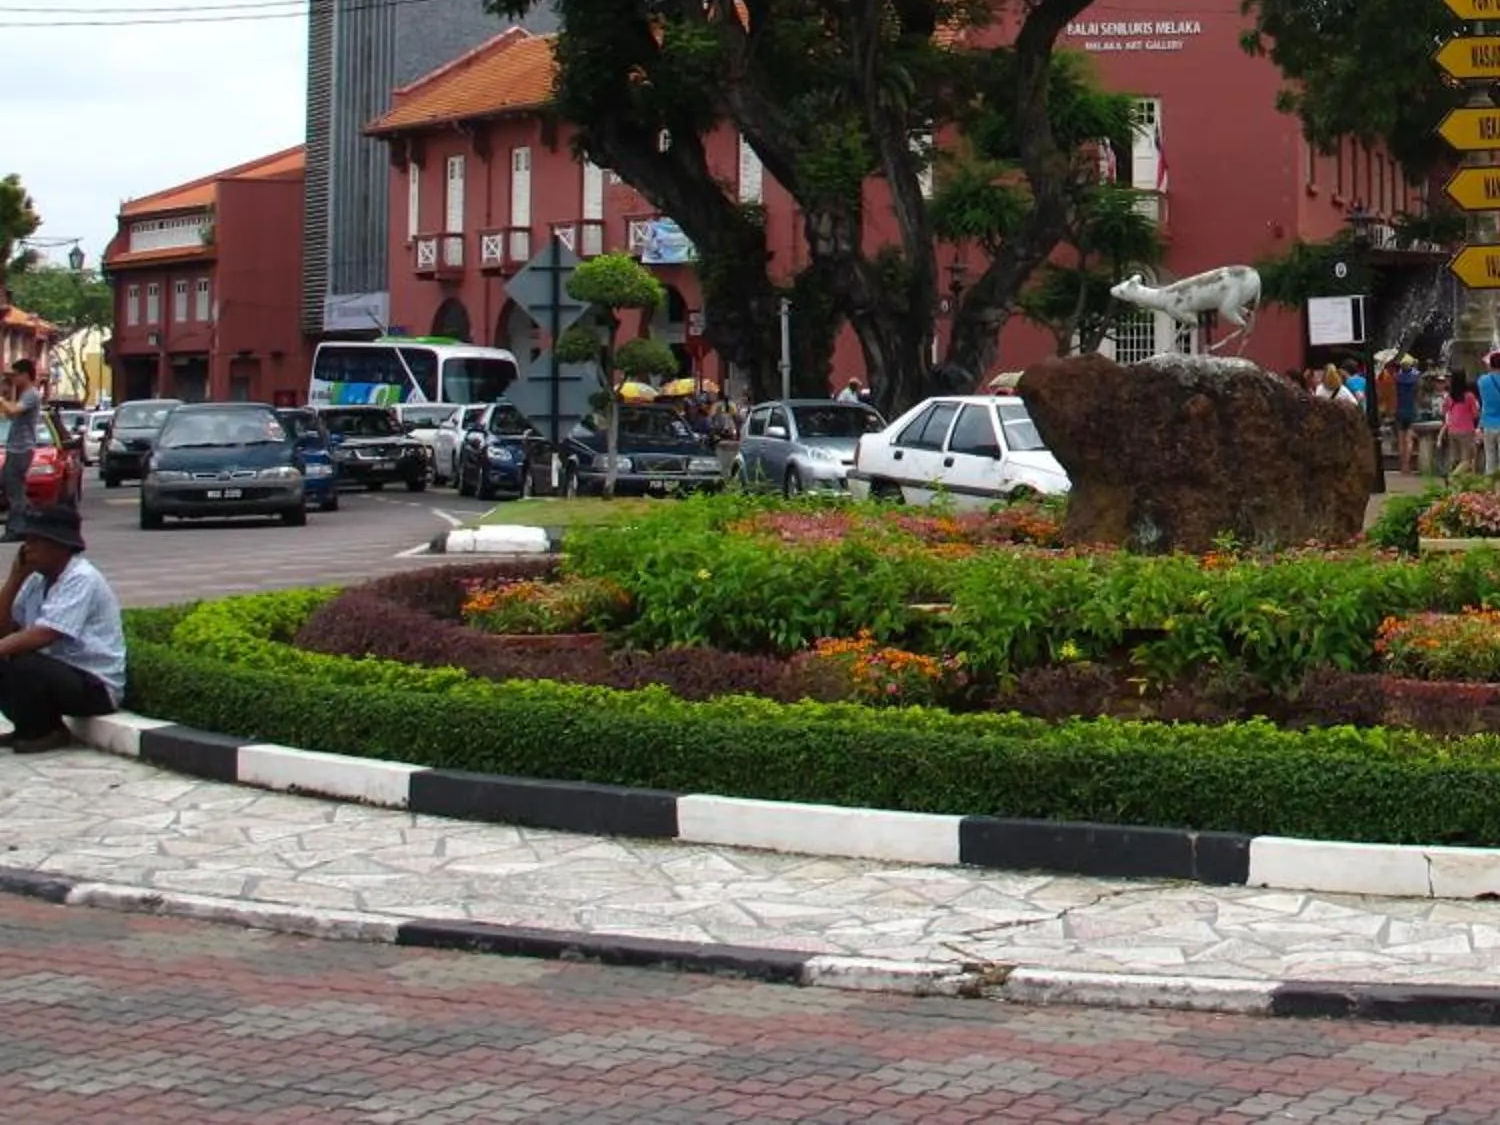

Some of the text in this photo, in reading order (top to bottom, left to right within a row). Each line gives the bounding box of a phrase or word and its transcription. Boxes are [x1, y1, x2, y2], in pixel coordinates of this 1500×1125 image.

[1067, 22, 1098, 35] BALAI
[1155, 20, 1200, 34] MELAKA
[1125, 41, 1142, 50] ART
[1146, 40, 1184, 50] GALLERY
